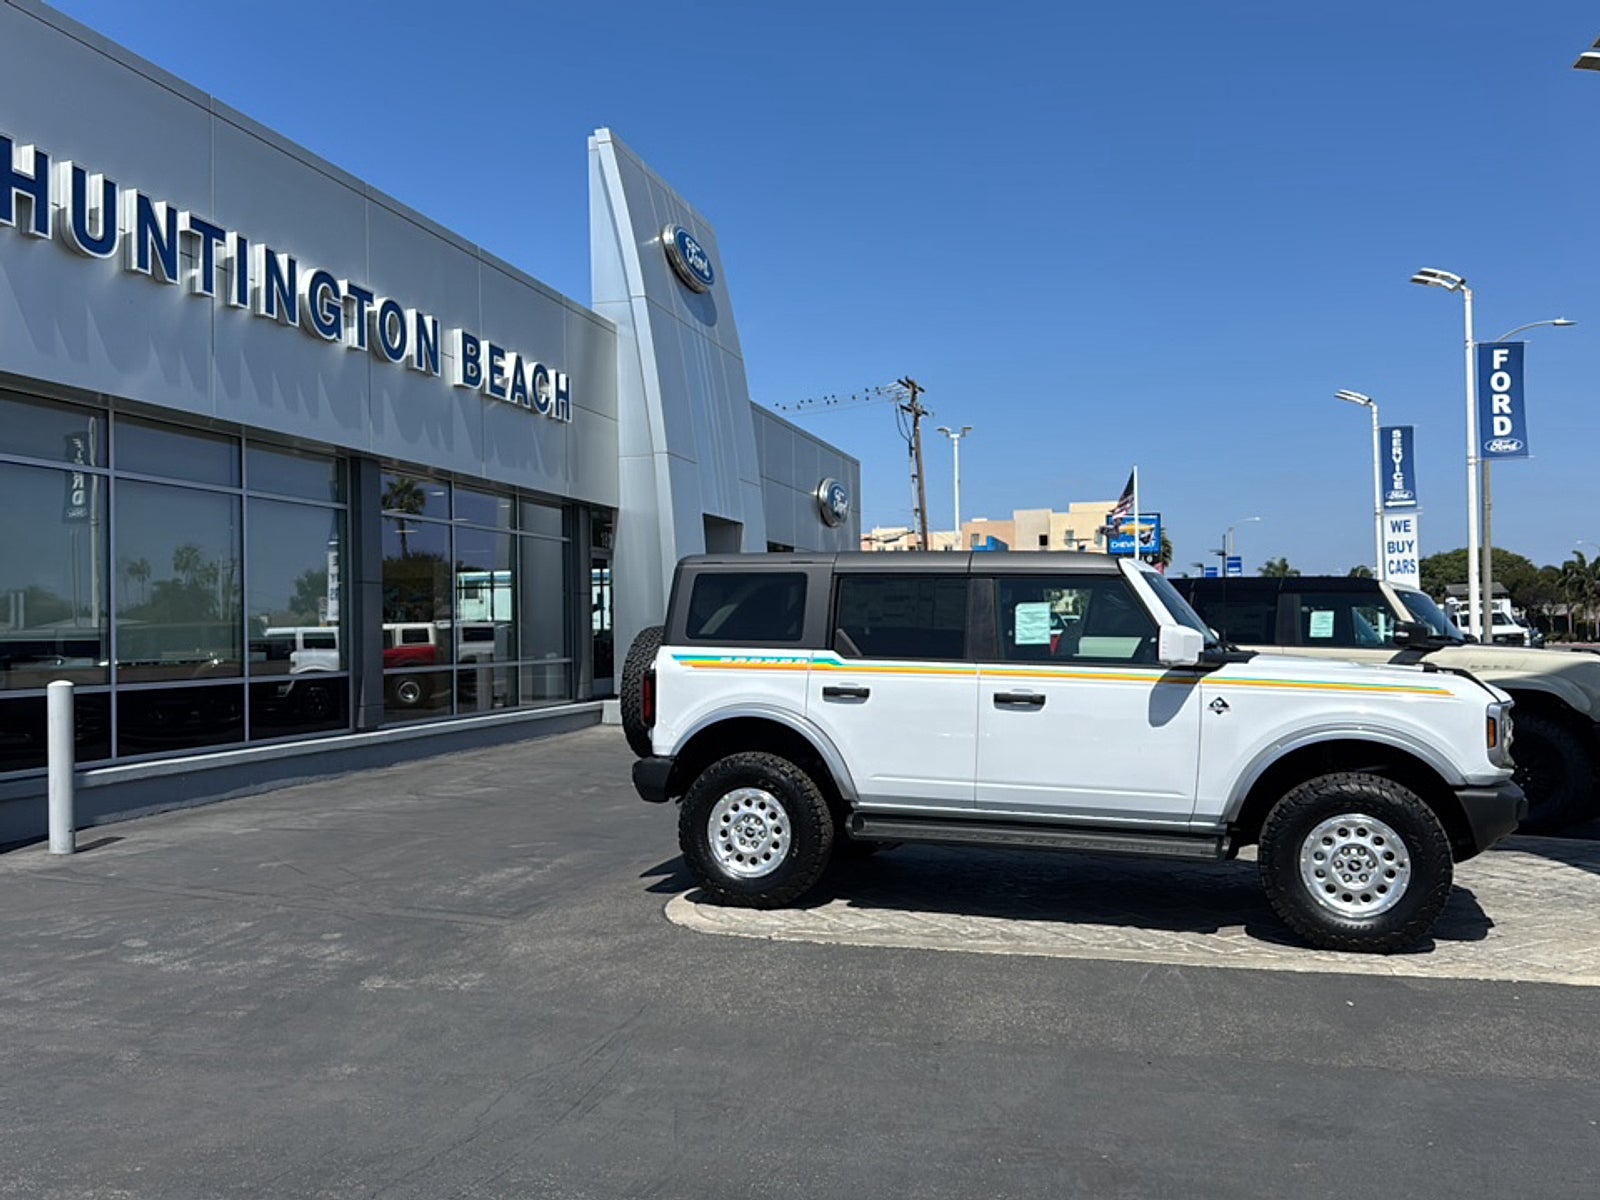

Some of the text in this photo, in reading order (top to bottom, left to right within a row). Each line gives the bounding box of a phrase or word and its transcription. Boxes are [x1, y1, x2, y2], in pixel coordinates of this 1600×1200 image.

[685, 236, 710, 278] Ford
[0, 132, 572, 423] HUNTINGTON BEACH
[1490, 349, 1512, 437] FORD
[1390, 519, 1411, 532] WE
[1387, 540, 1414, 554] BUY
[1388, 559, 1416, 574] CARS
